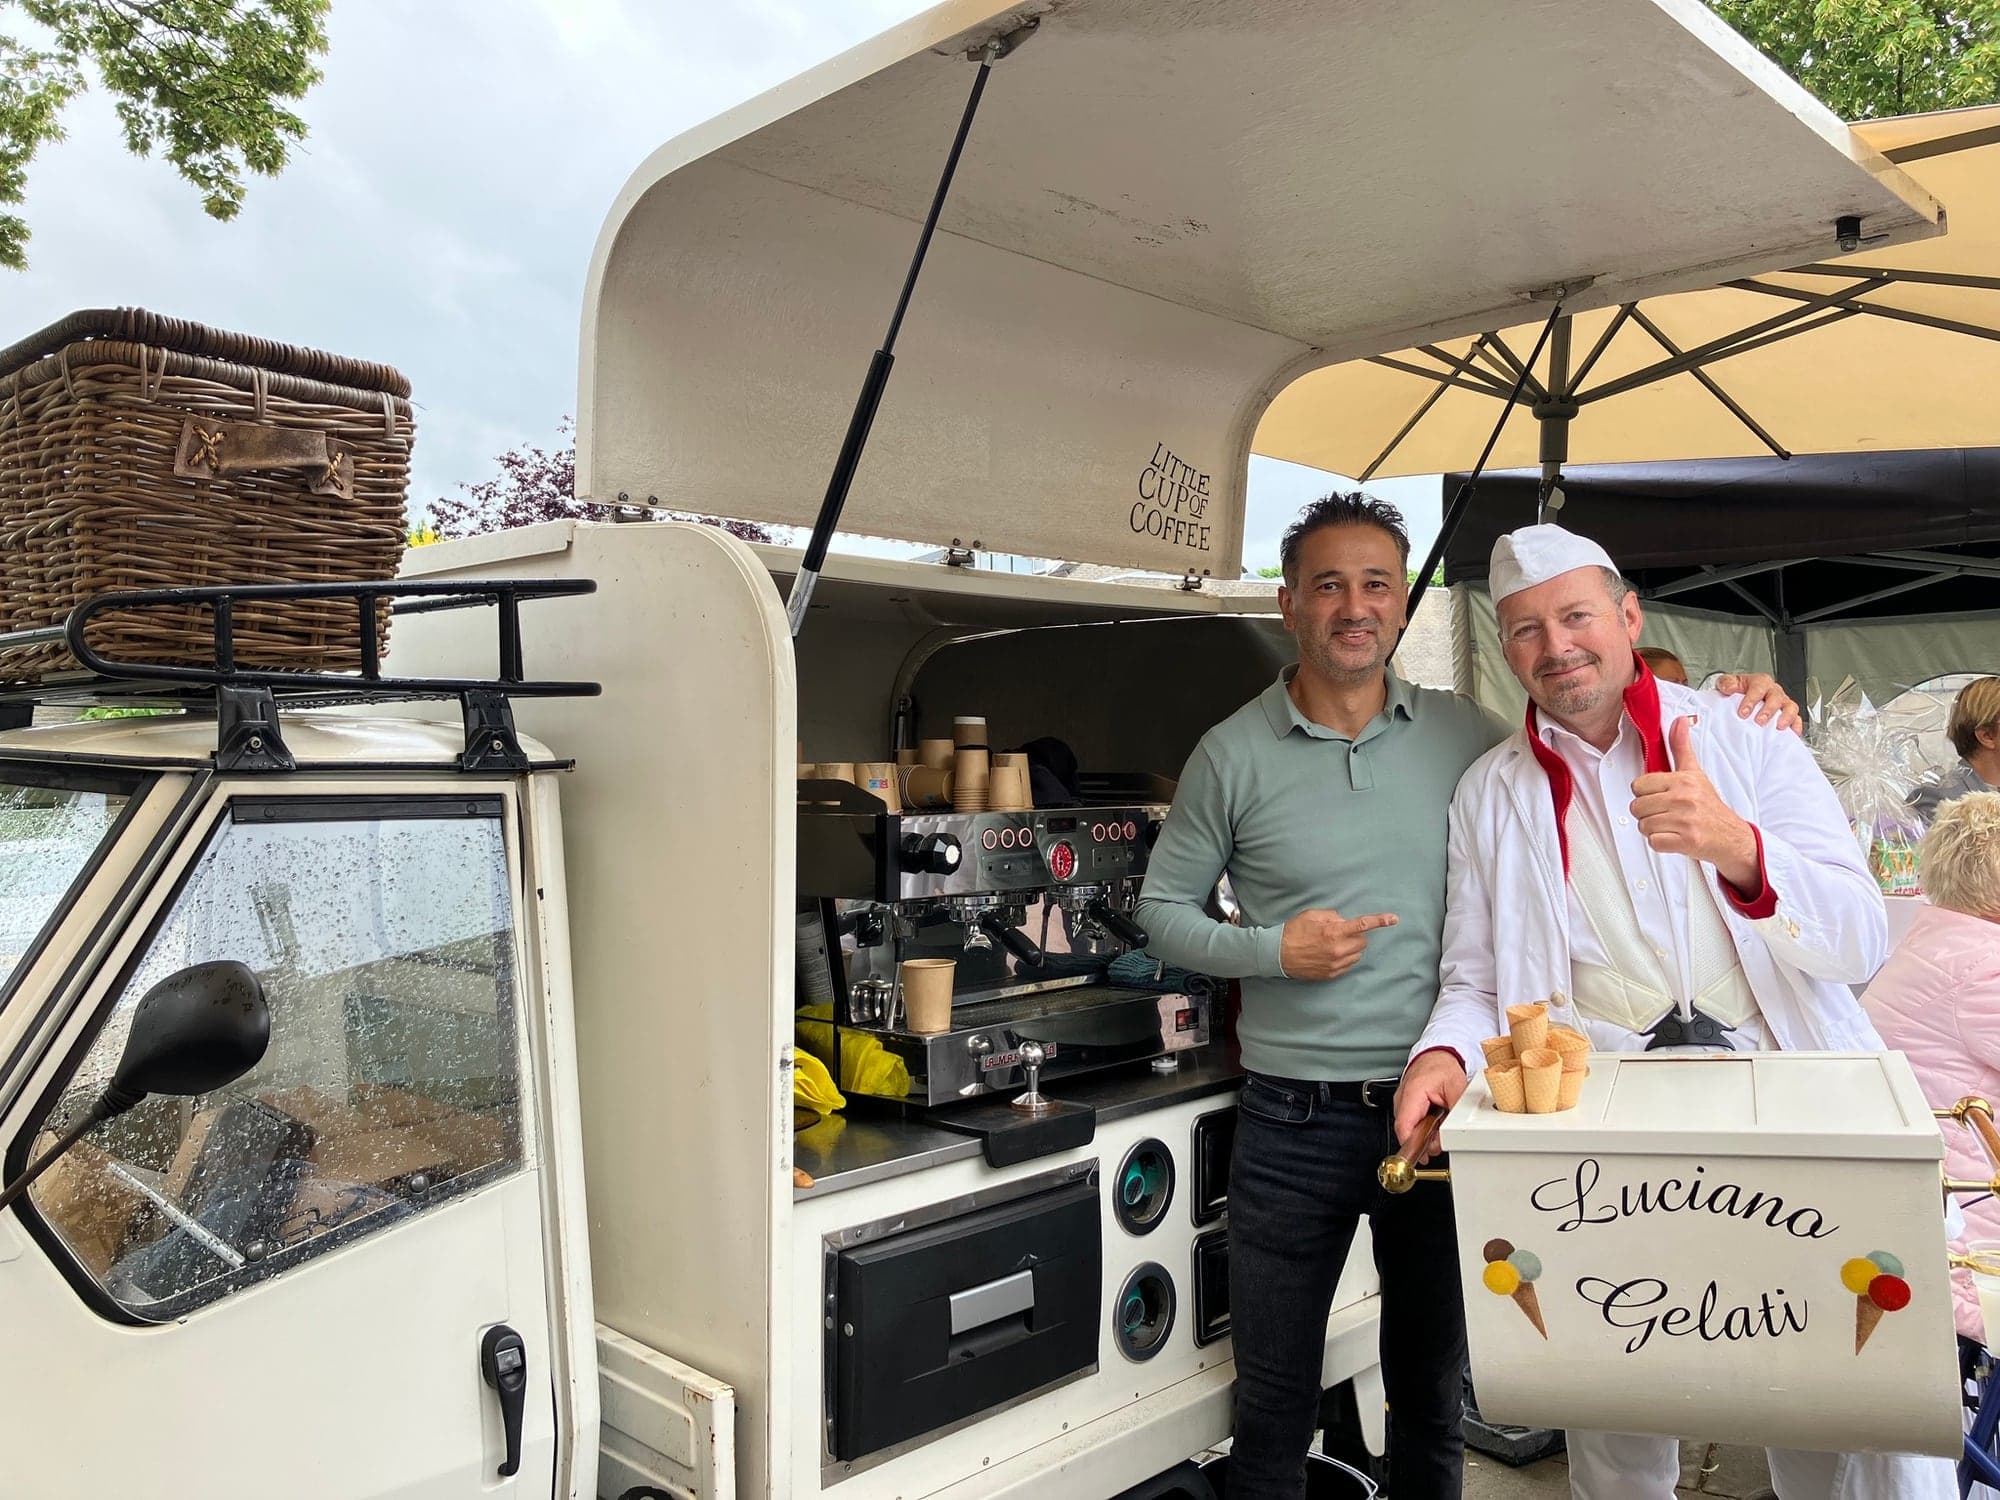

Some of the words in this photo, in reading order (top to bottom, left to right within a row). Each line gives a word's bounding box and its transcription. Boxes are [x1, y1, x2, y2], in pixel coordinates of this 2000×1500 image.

[1139, 467, 1189, 513] CUP
[1189, 494, 1208, 518] OF
[1150, 442, 1210, 495] LITTLE
[1130, 502, 1211, 551] COFFEE
[1531, 1158, 1839, 1239] Luciano
